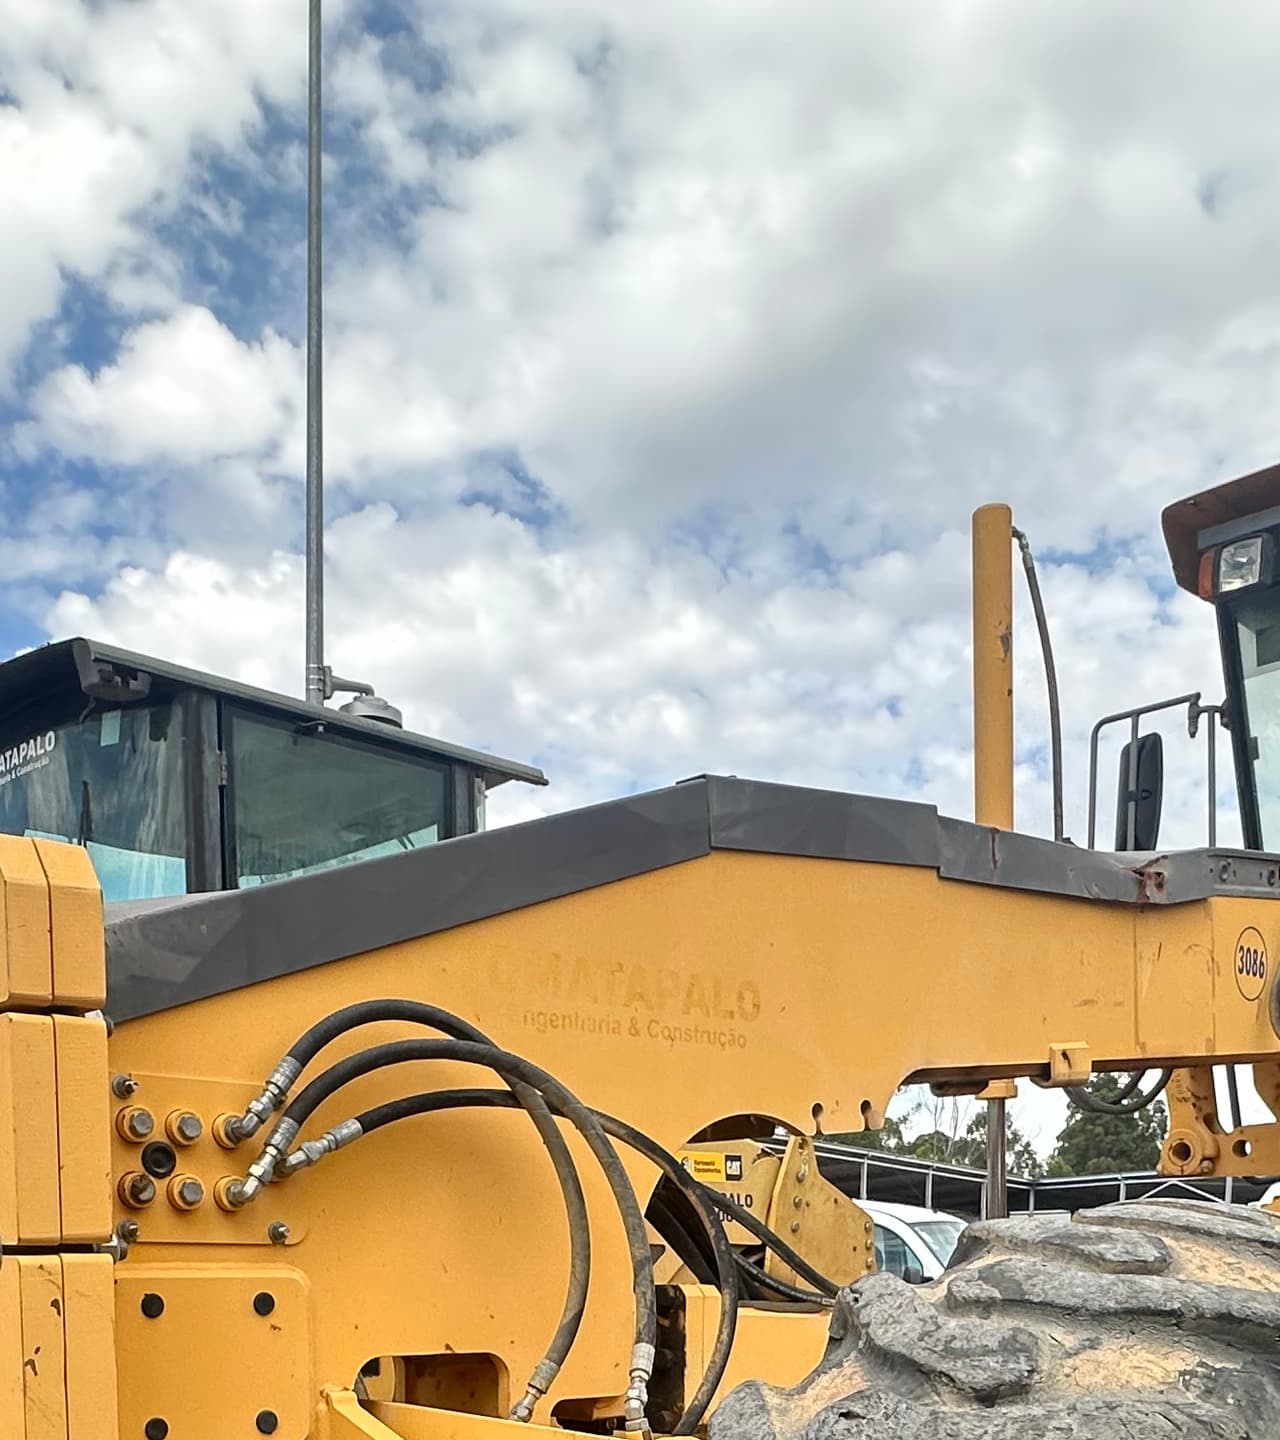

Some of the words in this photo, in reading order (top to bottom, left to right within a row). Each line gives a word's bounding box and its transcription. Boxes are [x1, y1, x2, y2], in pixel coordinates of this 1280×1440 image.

[1237, 945, 1265, 979] 3086
[521, 1009, 622, 1036] ngenharia
[627, 1016, 642, 1038] &
[726, 1160, 741, 1175] CAT
